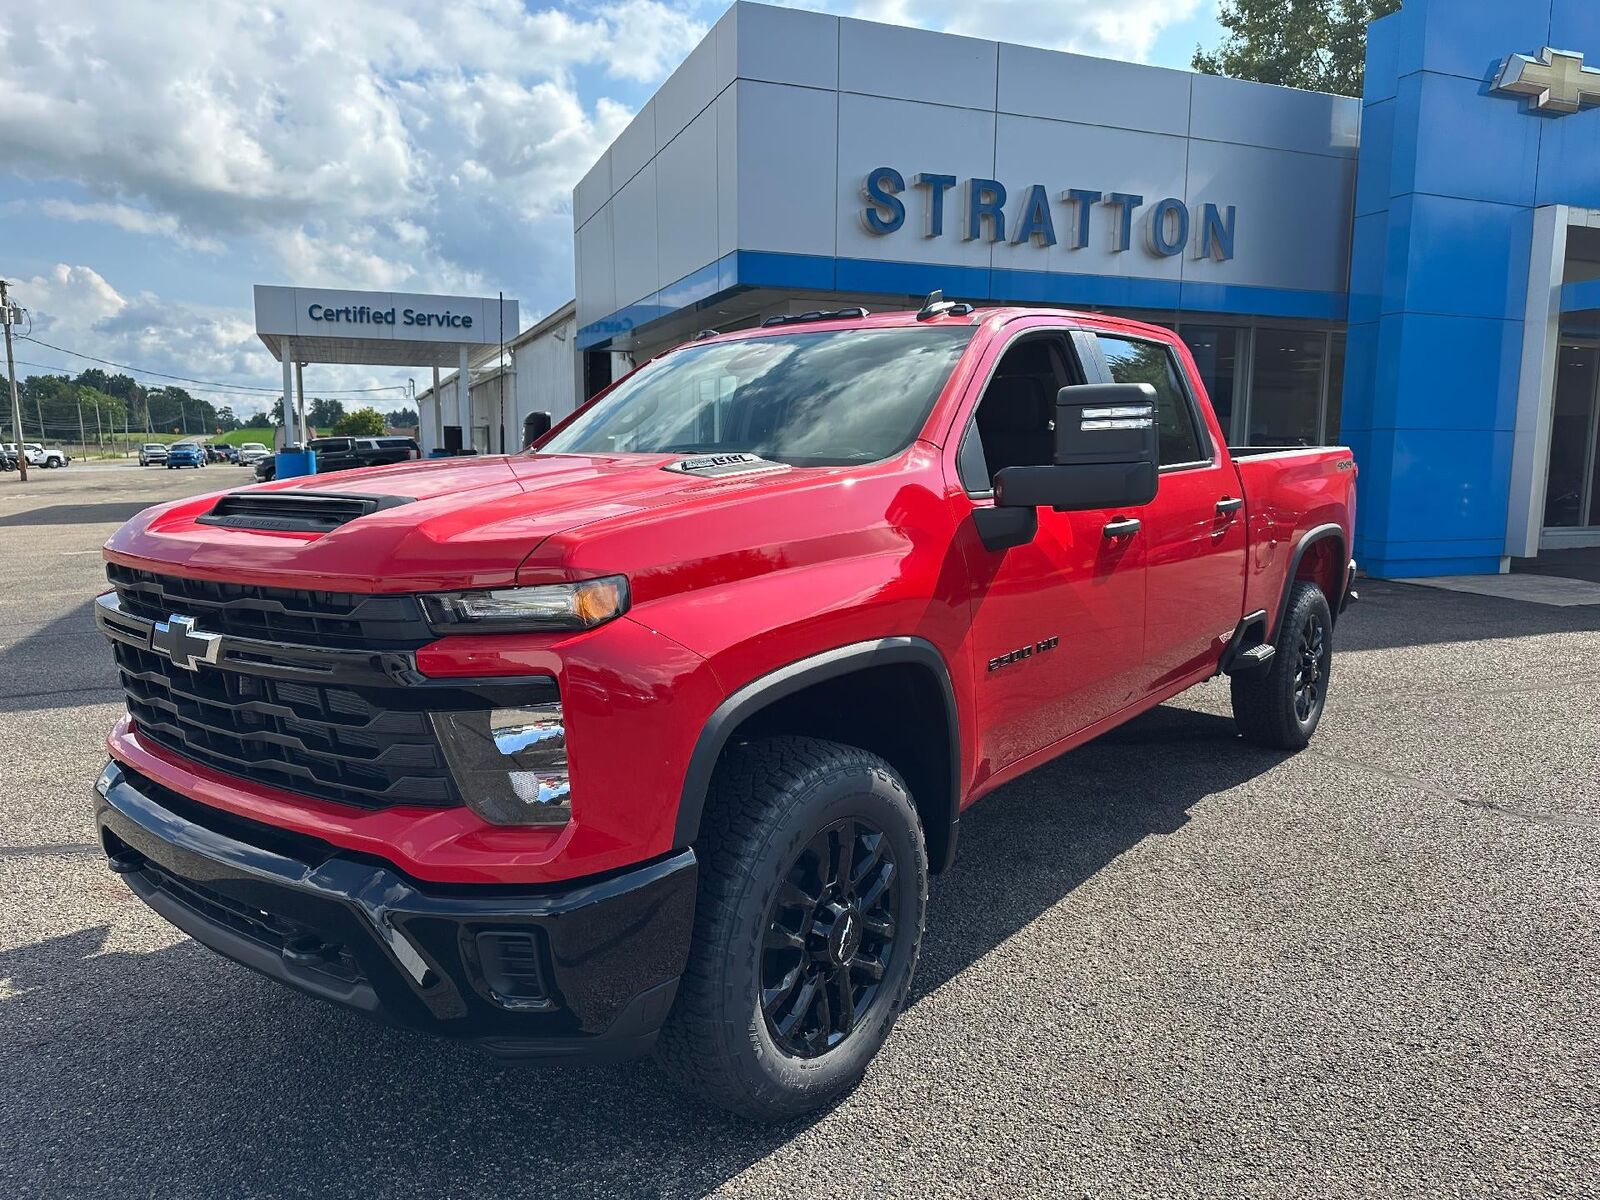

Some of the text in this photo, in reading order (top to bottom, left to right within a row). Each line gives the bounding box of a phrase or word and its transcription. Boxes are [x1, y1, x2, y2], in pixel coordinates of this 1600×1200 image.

[860, 167, 1236, 262] STRATTON
[308, 303, 473, 328] Certified Service
[1036, 635, 1059, 653] HD
